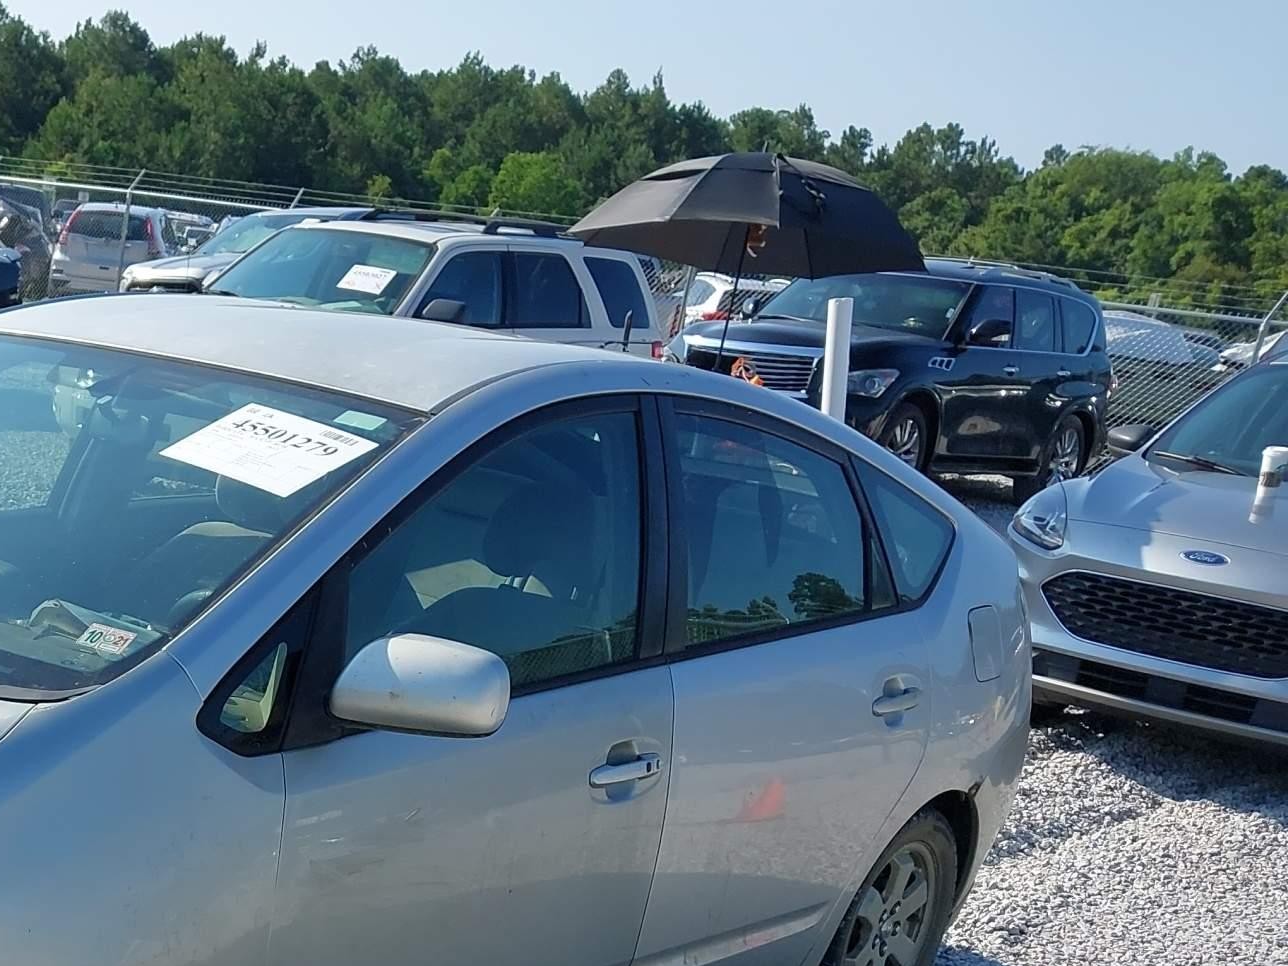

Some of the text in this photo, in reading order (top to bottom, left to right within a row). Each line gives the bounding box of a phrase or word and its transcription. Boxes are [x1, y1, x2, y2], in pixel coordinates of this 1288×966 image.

[232, 419, 338, 455] 45501279
[84, 630, 130, 647] 10 21
